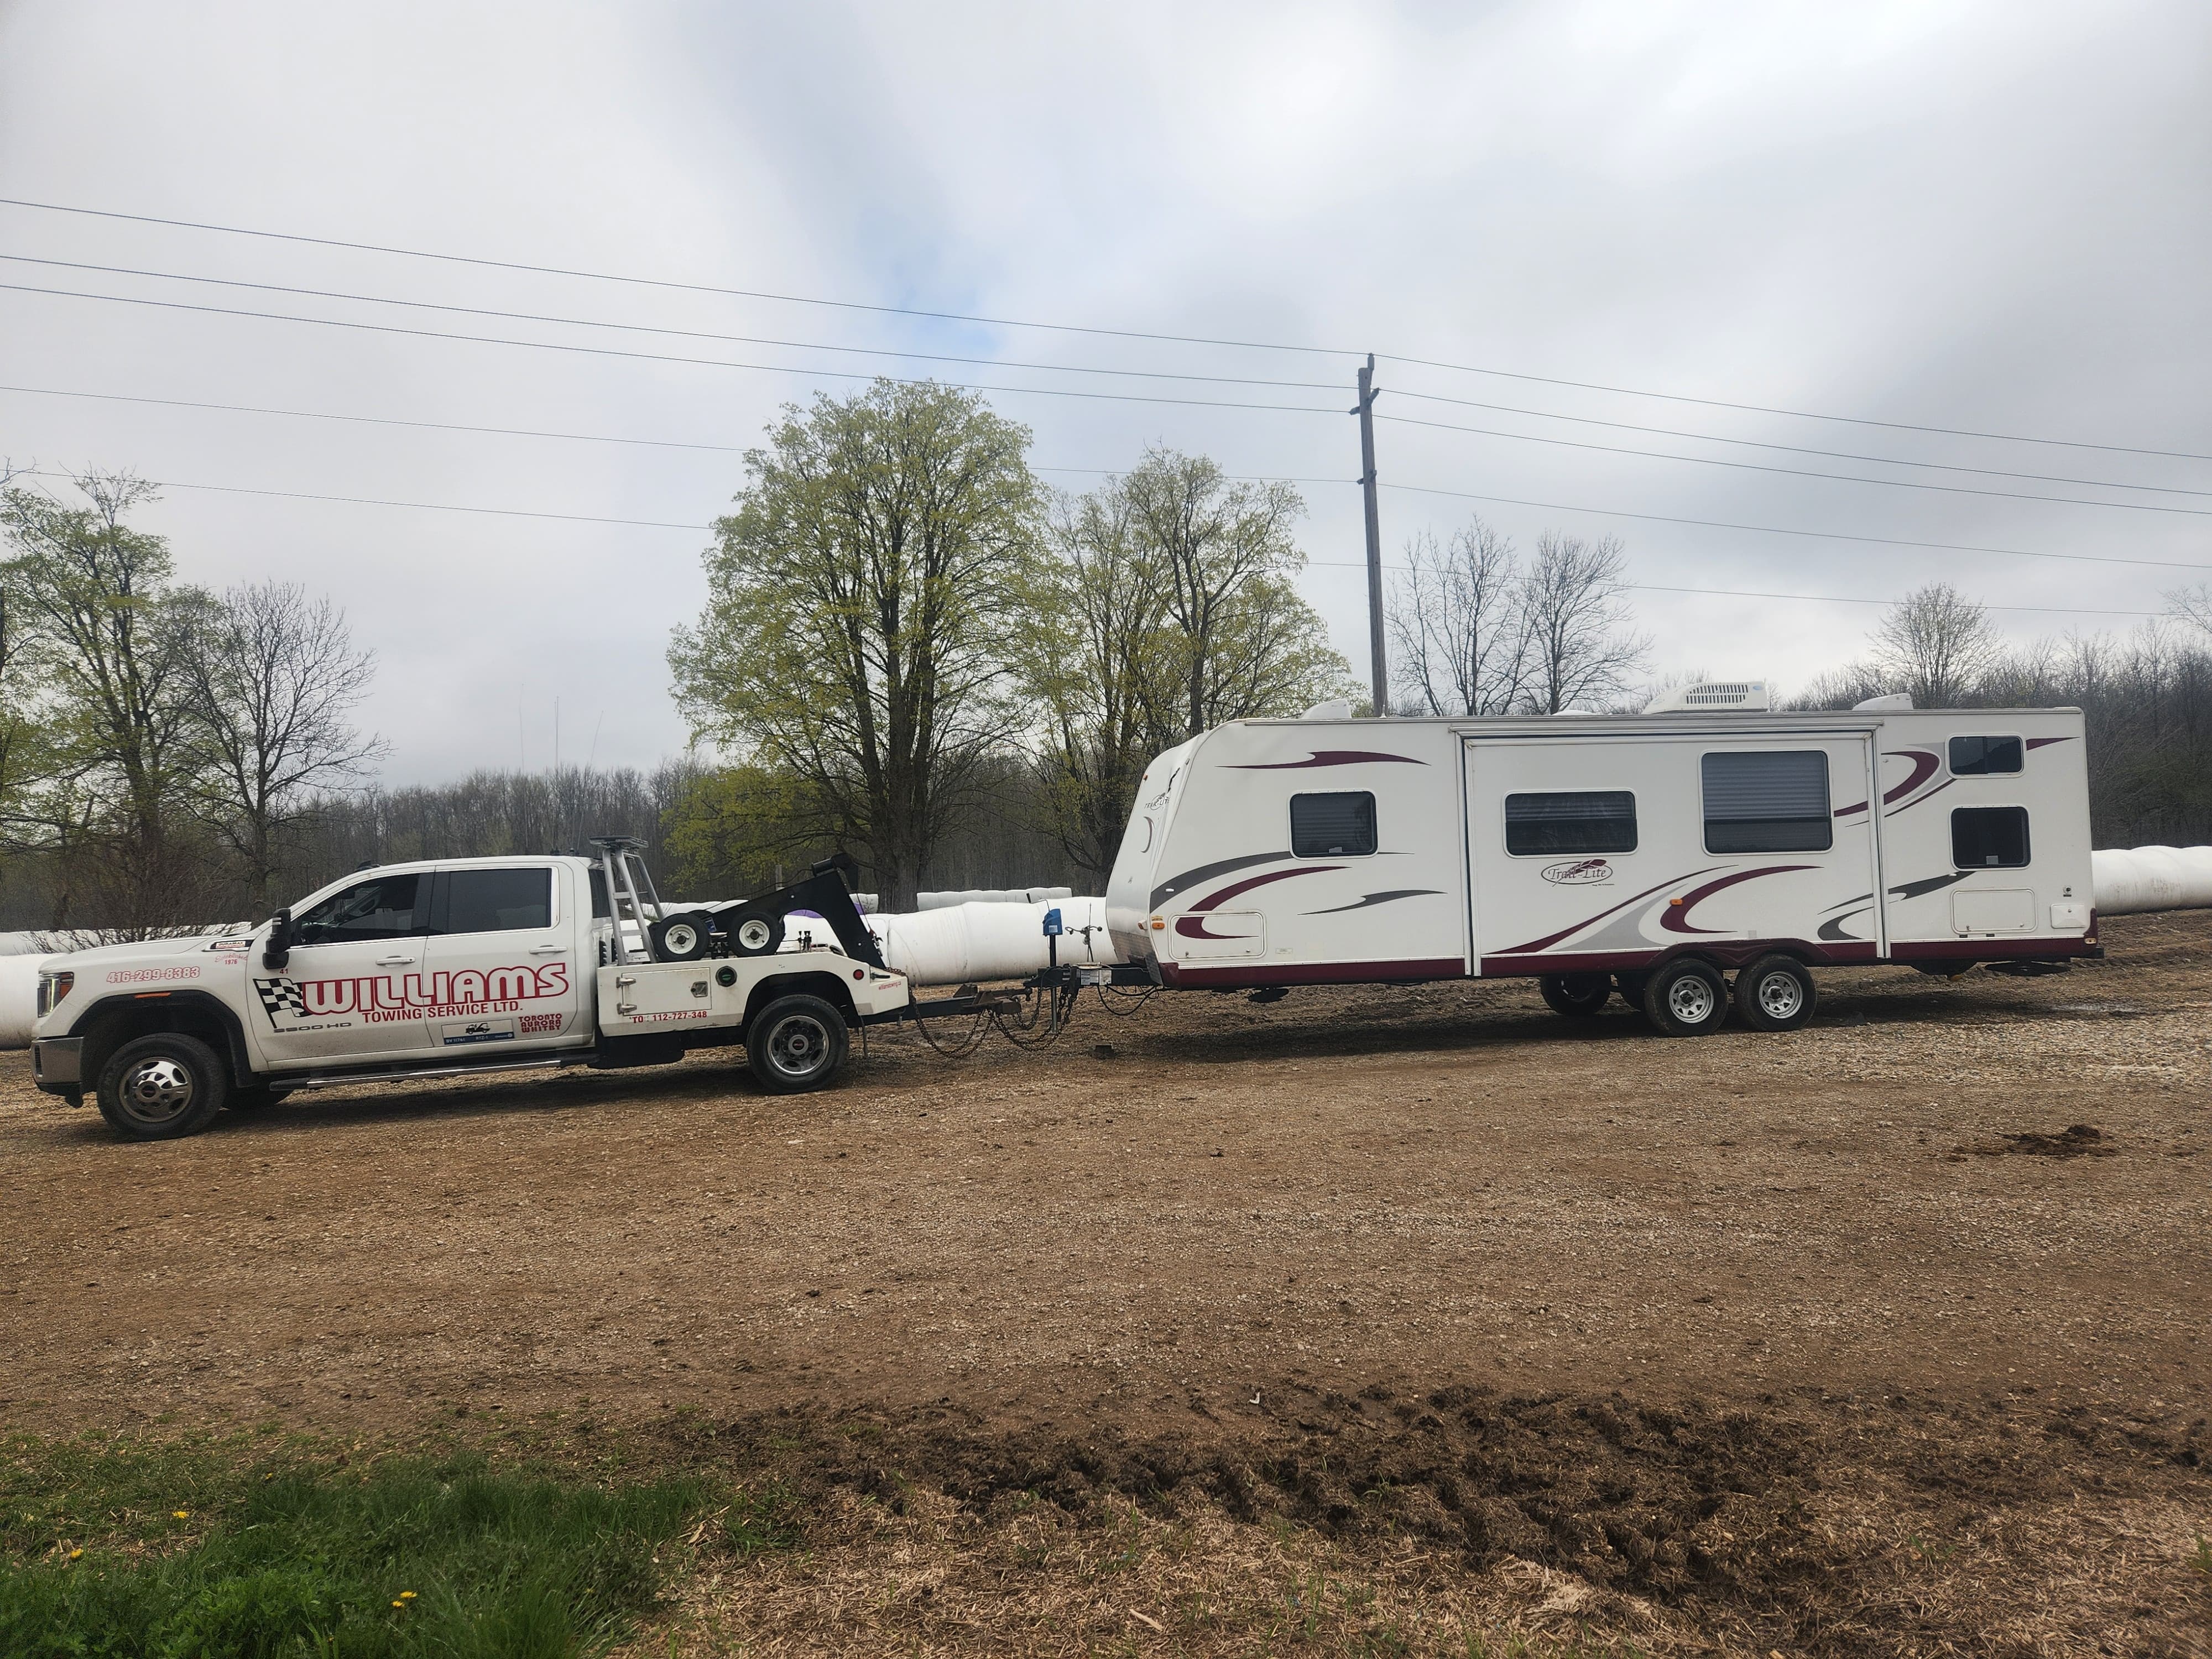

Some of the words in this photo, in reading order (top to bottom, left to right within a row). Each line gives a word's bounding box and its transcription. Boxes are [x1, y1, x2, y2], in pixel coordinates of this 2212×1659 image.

[106, 966, 200, 983] 416-299-8383
[302, 962, 569, 1016] WILLIAMS
[362, 1005, 422, 1023] TOWING
[427, 1003, 488, 1018] SERVICE
[494, 1001, 523, 1013] LTD.
[653, 1011, 707, 1021] 112-727-348
[518, 1013, 562, 1022] TORONTO
[274, 1024, 324, 1033] 3500
[521, 1019, 561, 1028] AURORA
